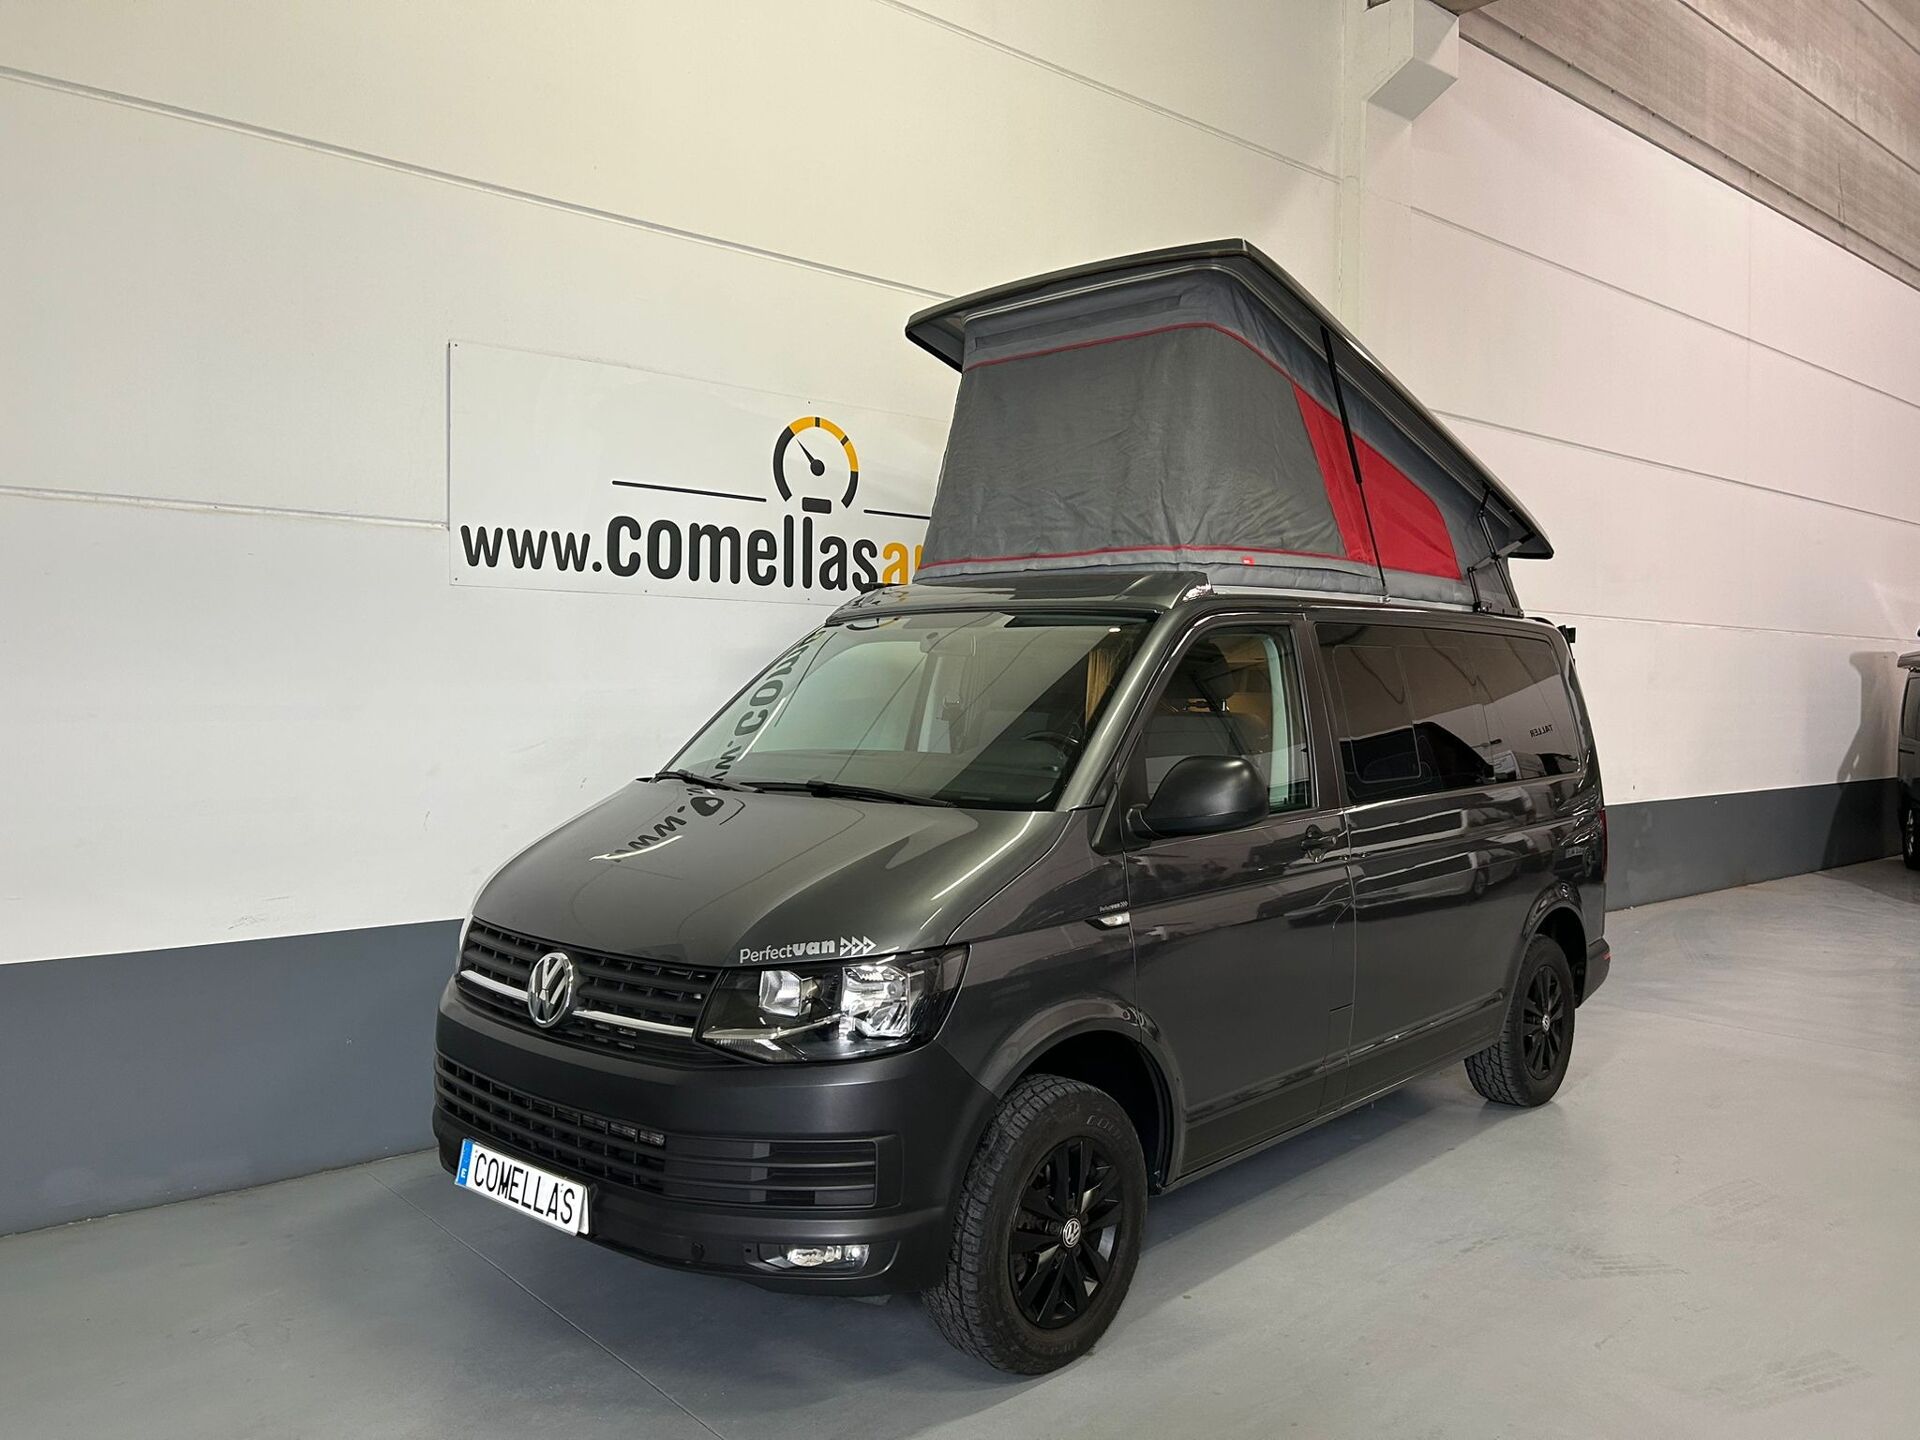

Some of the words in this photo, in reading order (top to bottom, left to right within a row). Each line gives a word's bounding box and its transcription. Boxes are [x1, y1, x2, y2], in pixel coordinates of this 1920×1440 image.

[739, 938, 836, 964] Perfectvan
[460, 1168, 467, 1179] E
[474, 1153, 576, 1224] COMELLAS
